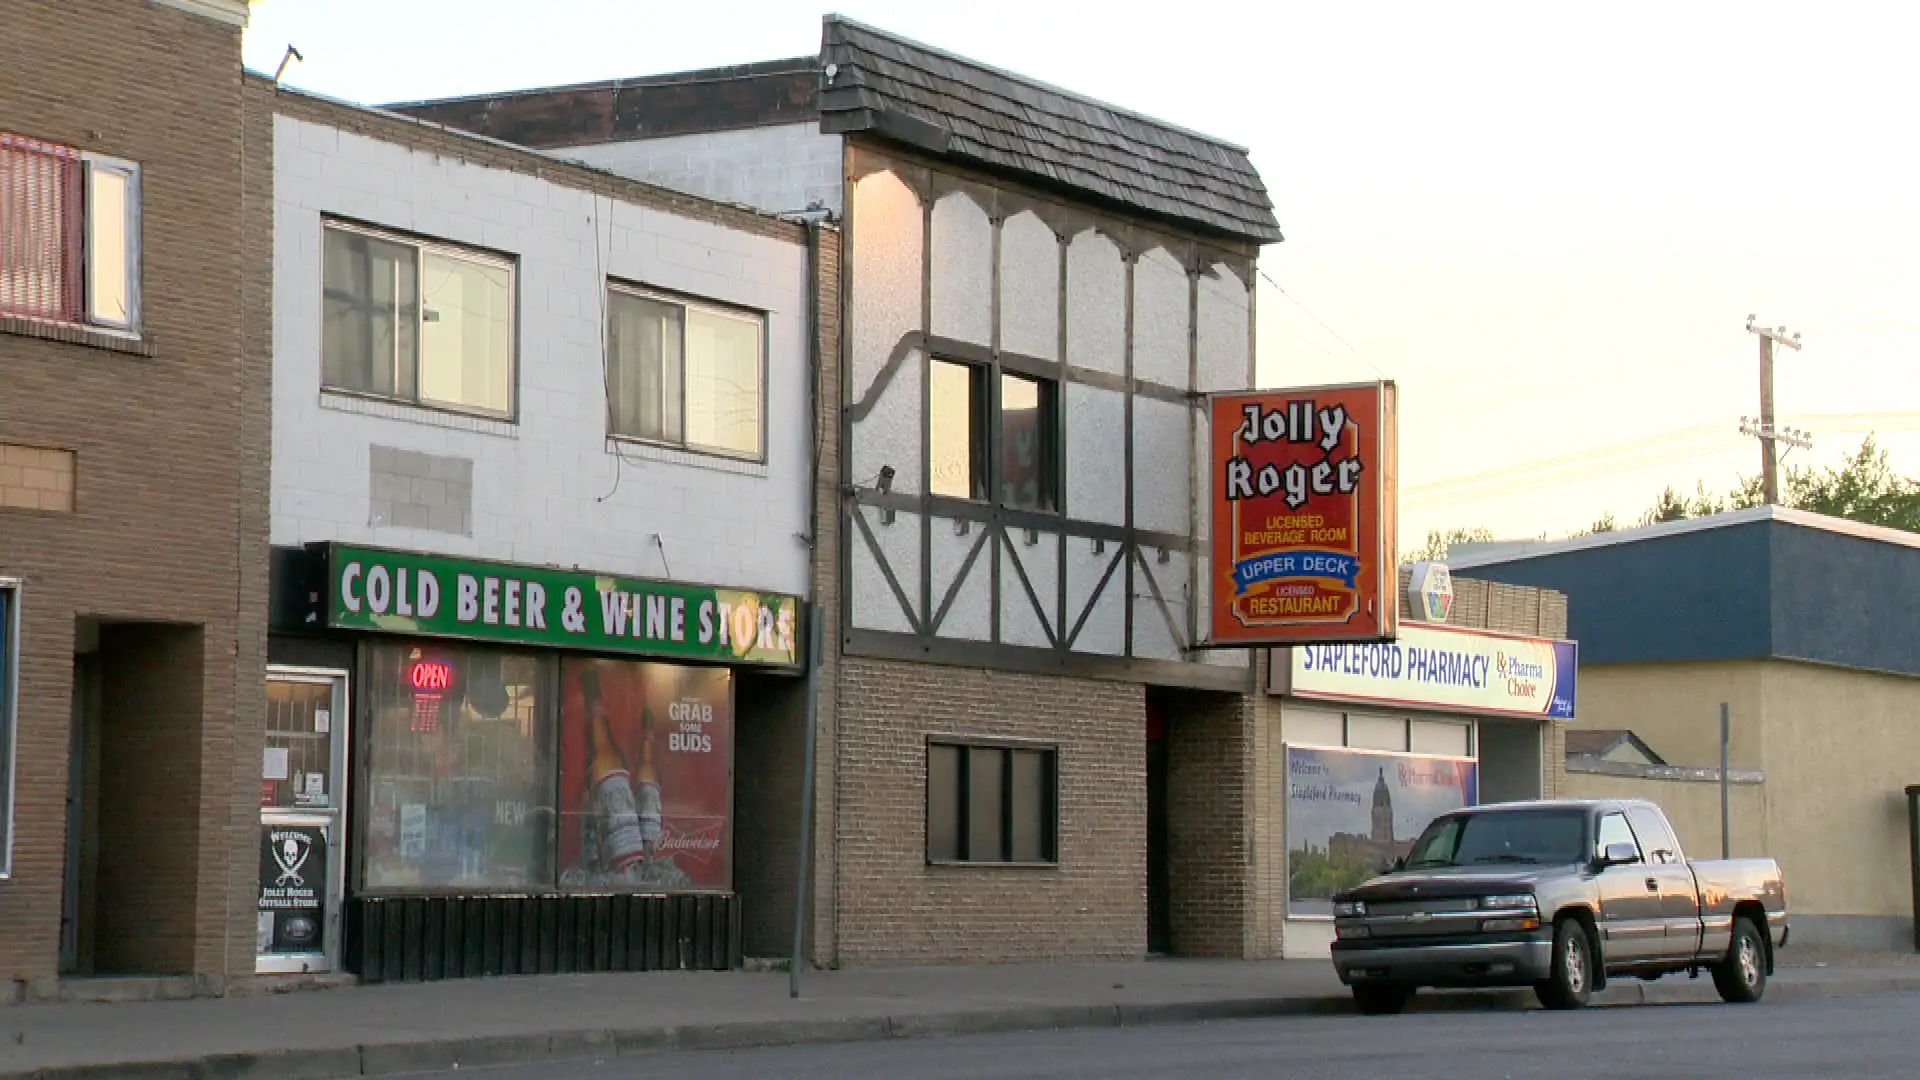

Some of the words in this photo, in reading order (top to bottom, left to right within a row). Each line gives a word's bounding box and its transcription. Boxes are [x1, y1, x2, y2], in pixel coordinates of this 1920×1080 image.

[1242, 400, 1344, 451] Jolly
[1226, 456, 1363, 510] Roger
[1266, 514, 1324, 529] LICENSED
[1245, 529, 1305, 545] BEVERAGE
[1311, 528, 1347, 542] ROOM
[1242, 557, 1295, 579] UPPER
[1303, 556, 1350, 575] DECK
[340, 561, 440, 617] COLD
[457, 573, 548, 630] BEER
[562, 587, 586, 633] &
[601, 591, 685, 642] WINE
[698, 599, 793, 651] STORE
[1250, 596, 1341, 615] RESTAURANT
[413, 663, 449, 688] OPEN
[1304, 643, 1401, 679] STAPLEFORD
[1407, 647, 1490, 688] PHARMACY
[1508, 656, 1543, 678] Pharma
[1507, 677, 1537, 698] Choice
[669, 702, 713, 722] GRAB
[669, 733, 712, 752] BUDS
